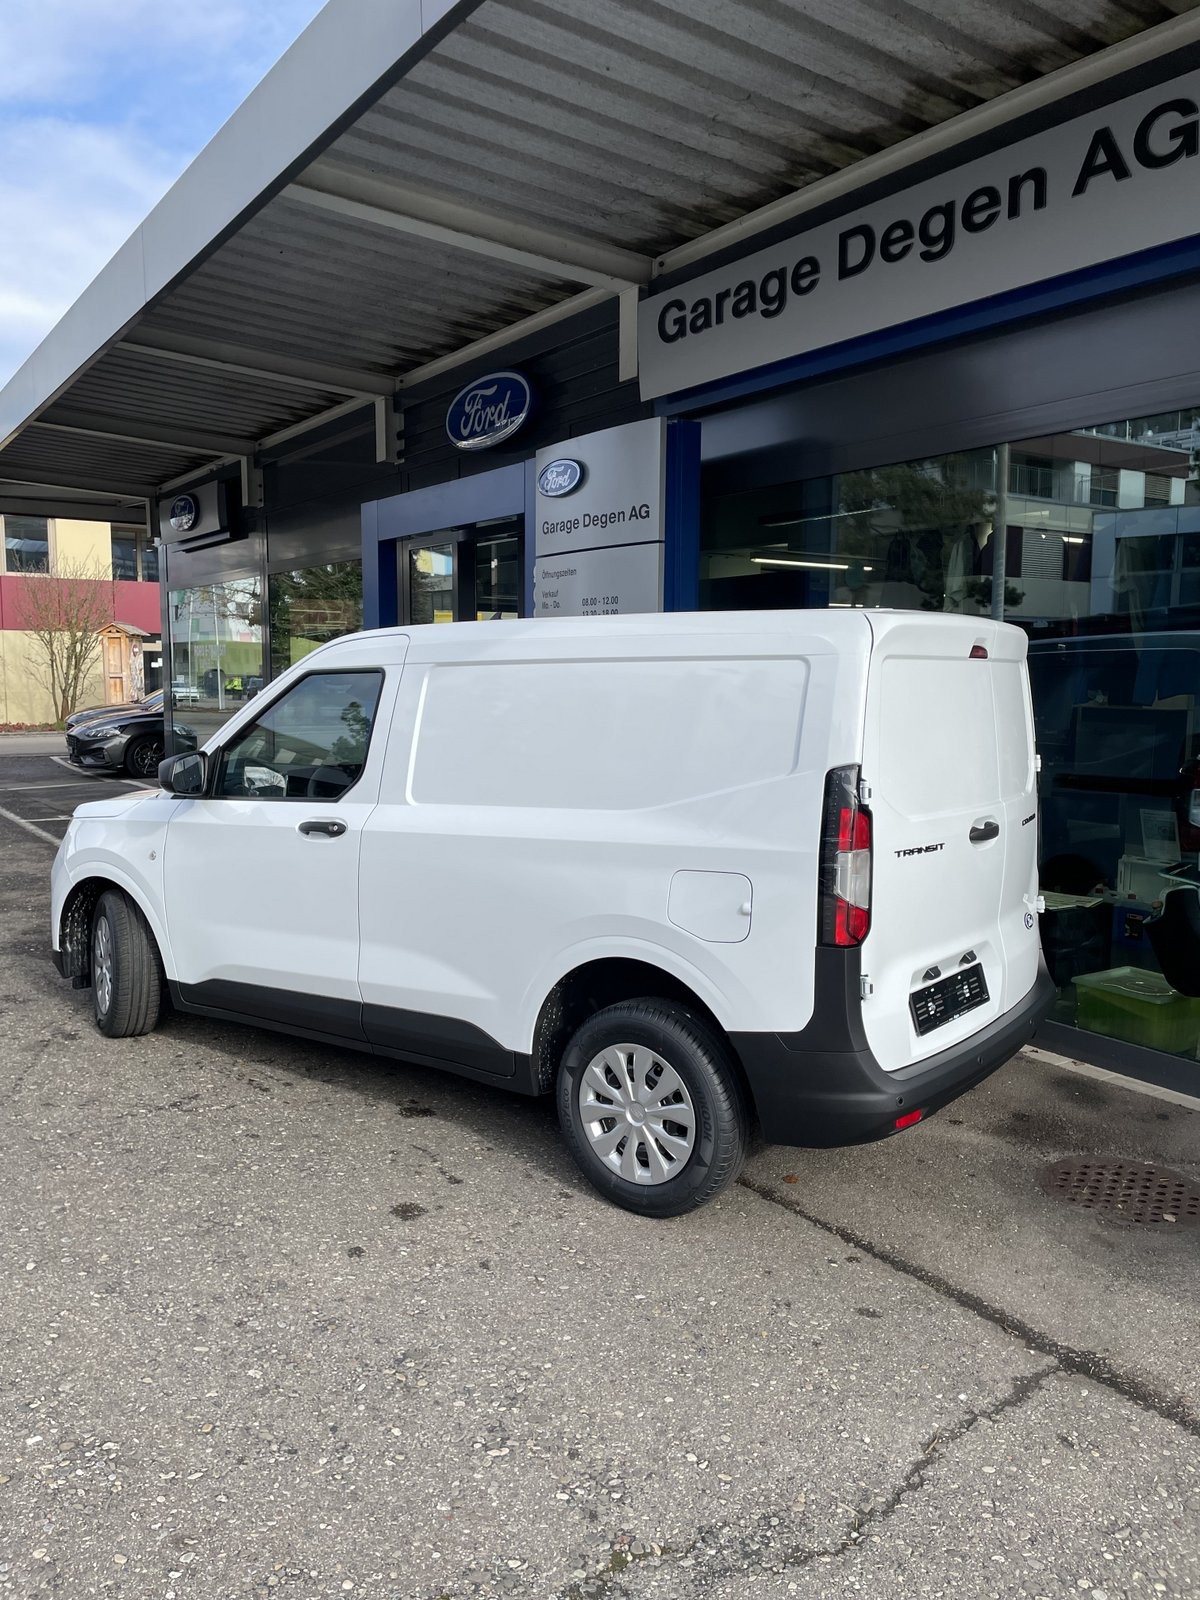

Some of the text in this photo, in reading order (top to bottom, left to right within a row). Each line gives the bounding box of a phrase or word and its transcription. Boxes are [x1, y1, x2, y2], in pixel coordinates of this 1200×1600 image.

[657, 97, 1200, 344] Garage Degen AG
[460, 384, 512, 436] Ford
[544, 465, 572, 491] Ford
[542, 503, 651, 535] Garage Degen AG
[581, 597, 598, 607] 08.00
[602, 595, 619, 605] 12.00
[893, 842, 946, 859] TRANSIT
